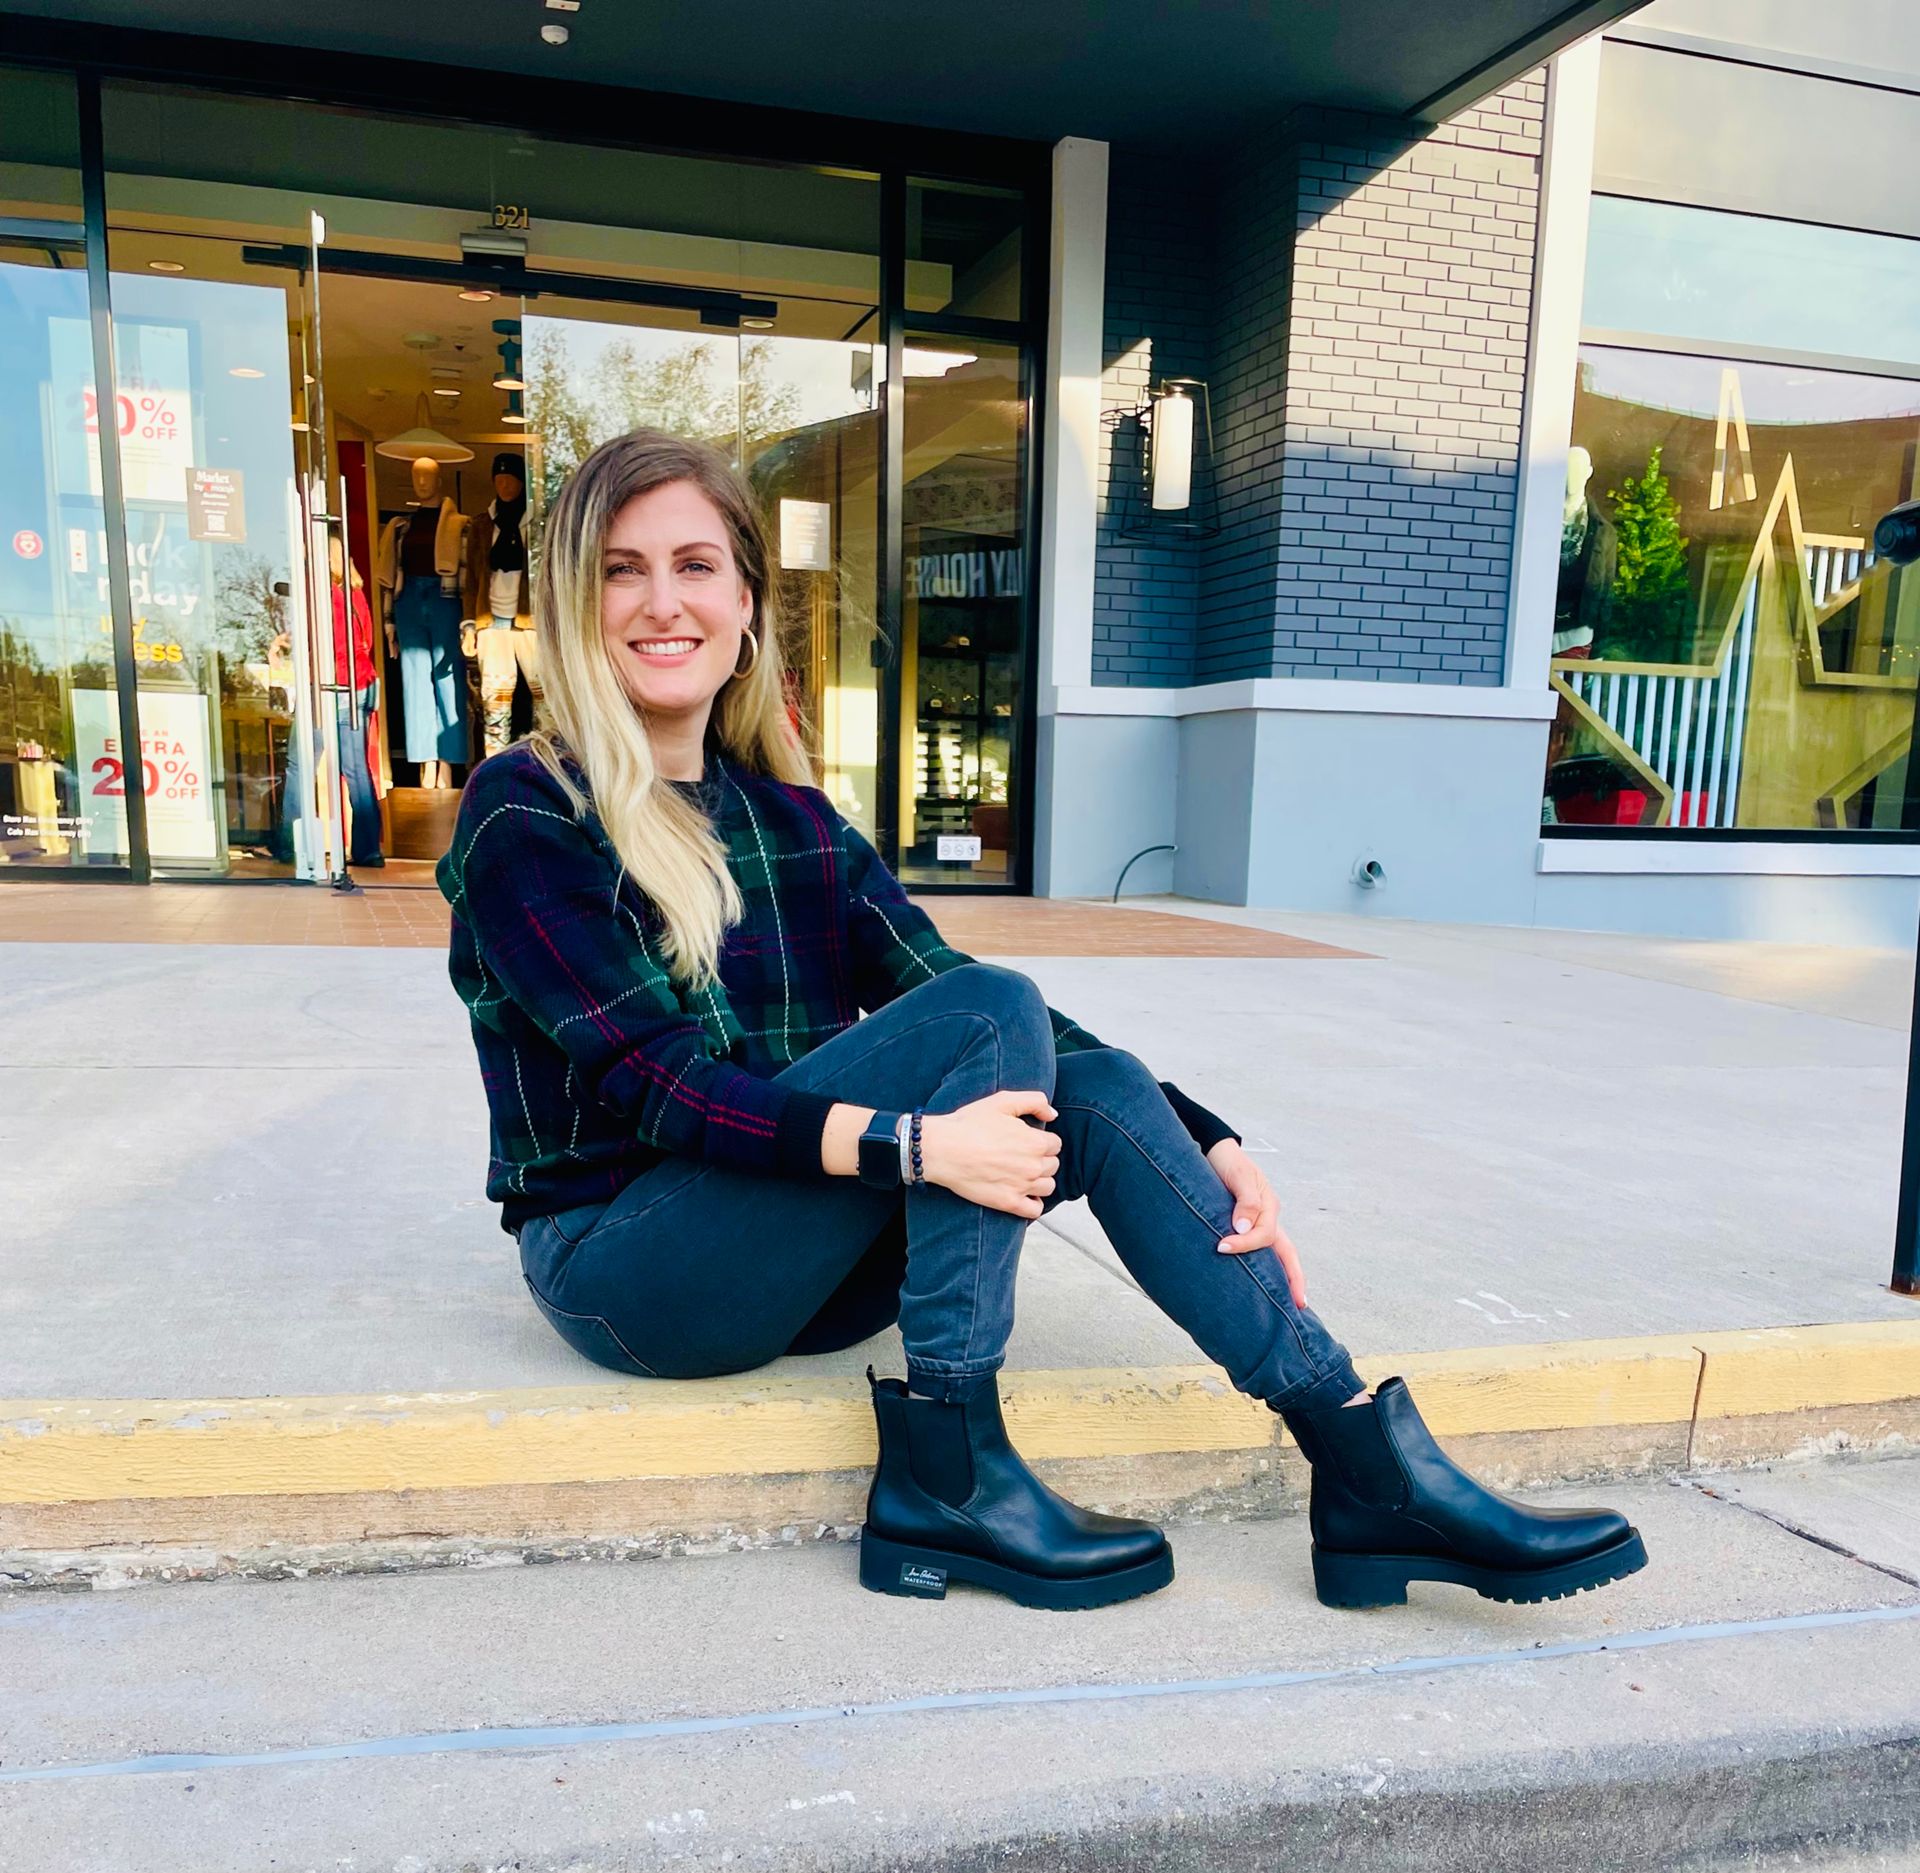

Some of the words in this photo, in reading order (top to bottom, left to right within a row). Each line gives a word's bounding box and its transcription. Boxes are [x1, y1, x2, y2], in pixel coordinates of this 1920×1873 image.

[495, 204, 530, 230] 321
[141, 426, 179, 440] OFF
[104, 738, 185, 756] ETRA
[165, 787, 200, 800] OFF
[904, 1577, 942, 1587] WATERPROOF
